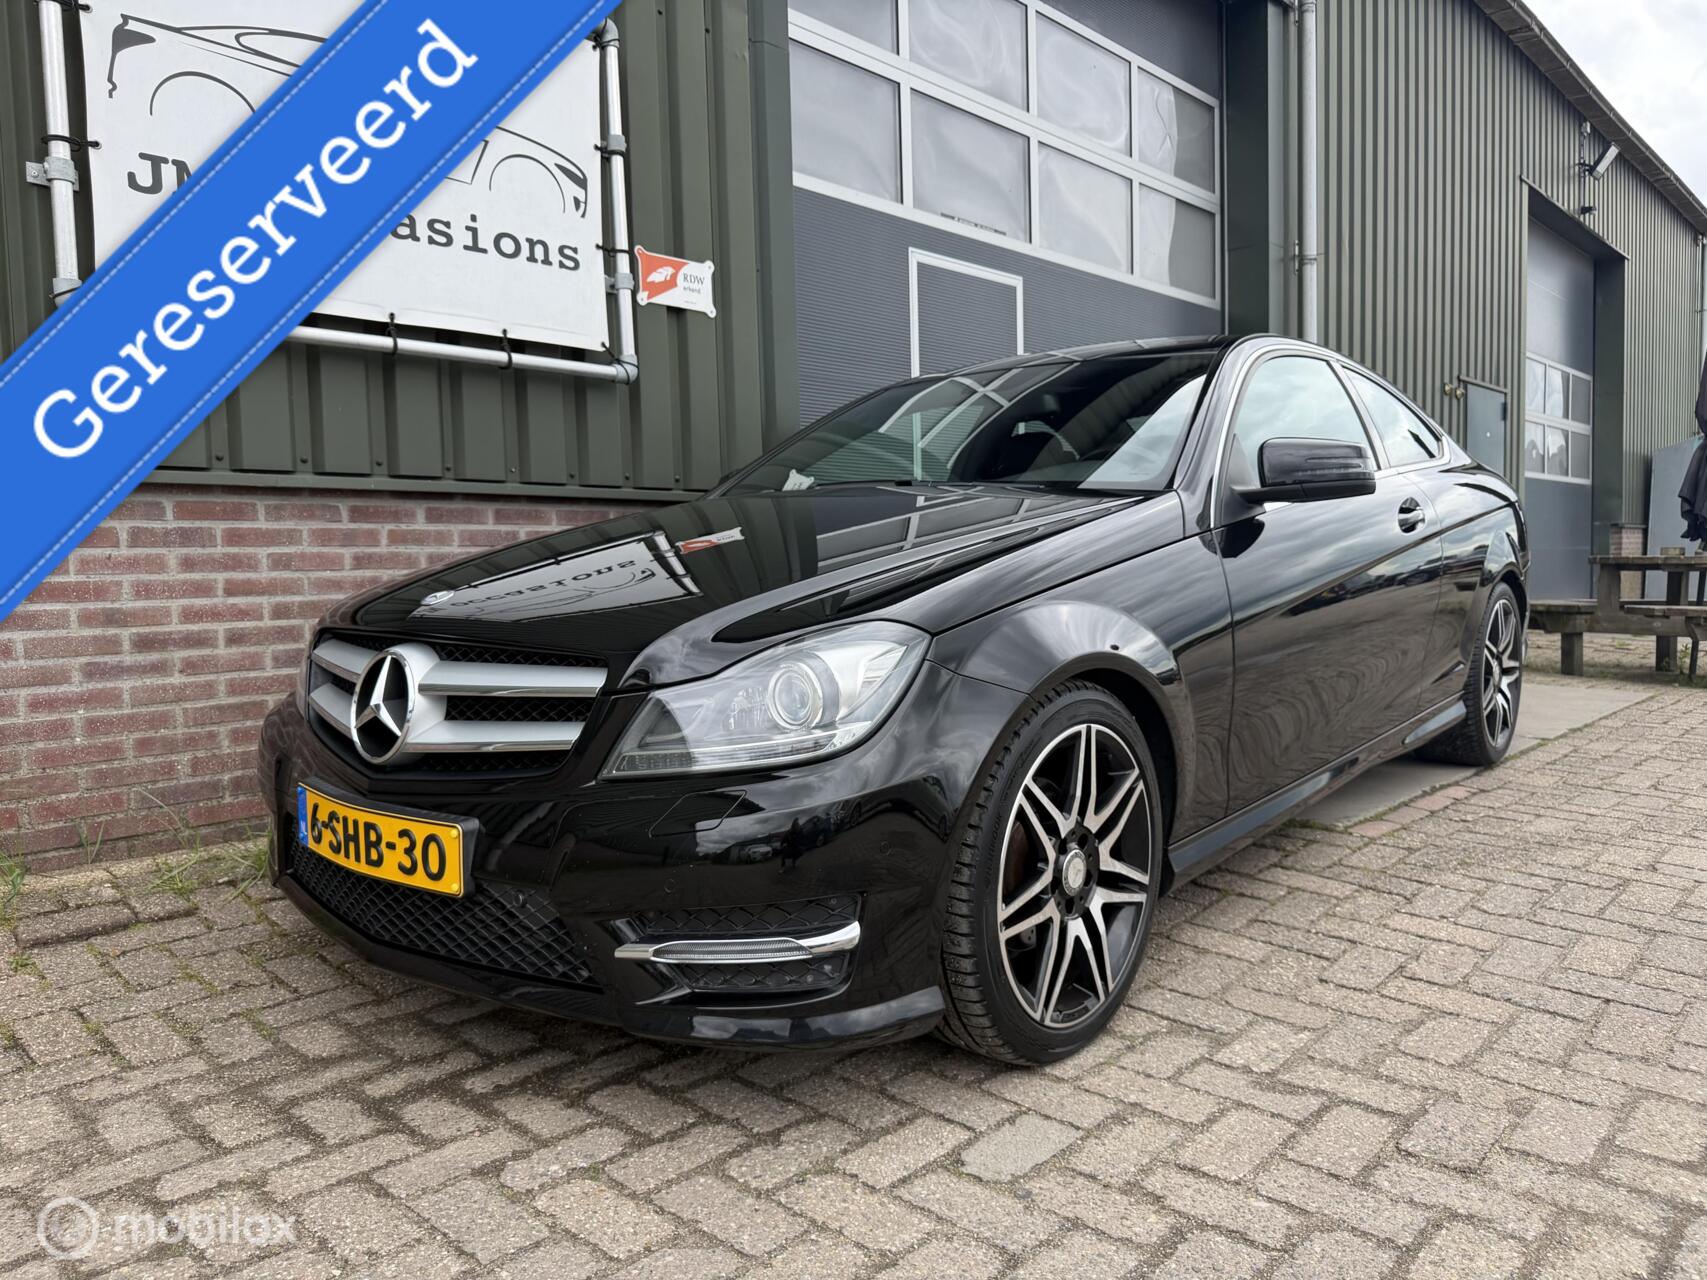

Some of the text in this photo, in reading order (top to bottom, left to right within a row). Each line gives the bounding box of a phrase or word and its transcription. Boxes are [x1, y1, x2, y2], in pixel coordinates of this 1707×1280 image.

[390, 213, 581, 271] asions
[683, 272, 706, 285] RDW
[311, 802, 446, 882] 6-SHB-30
